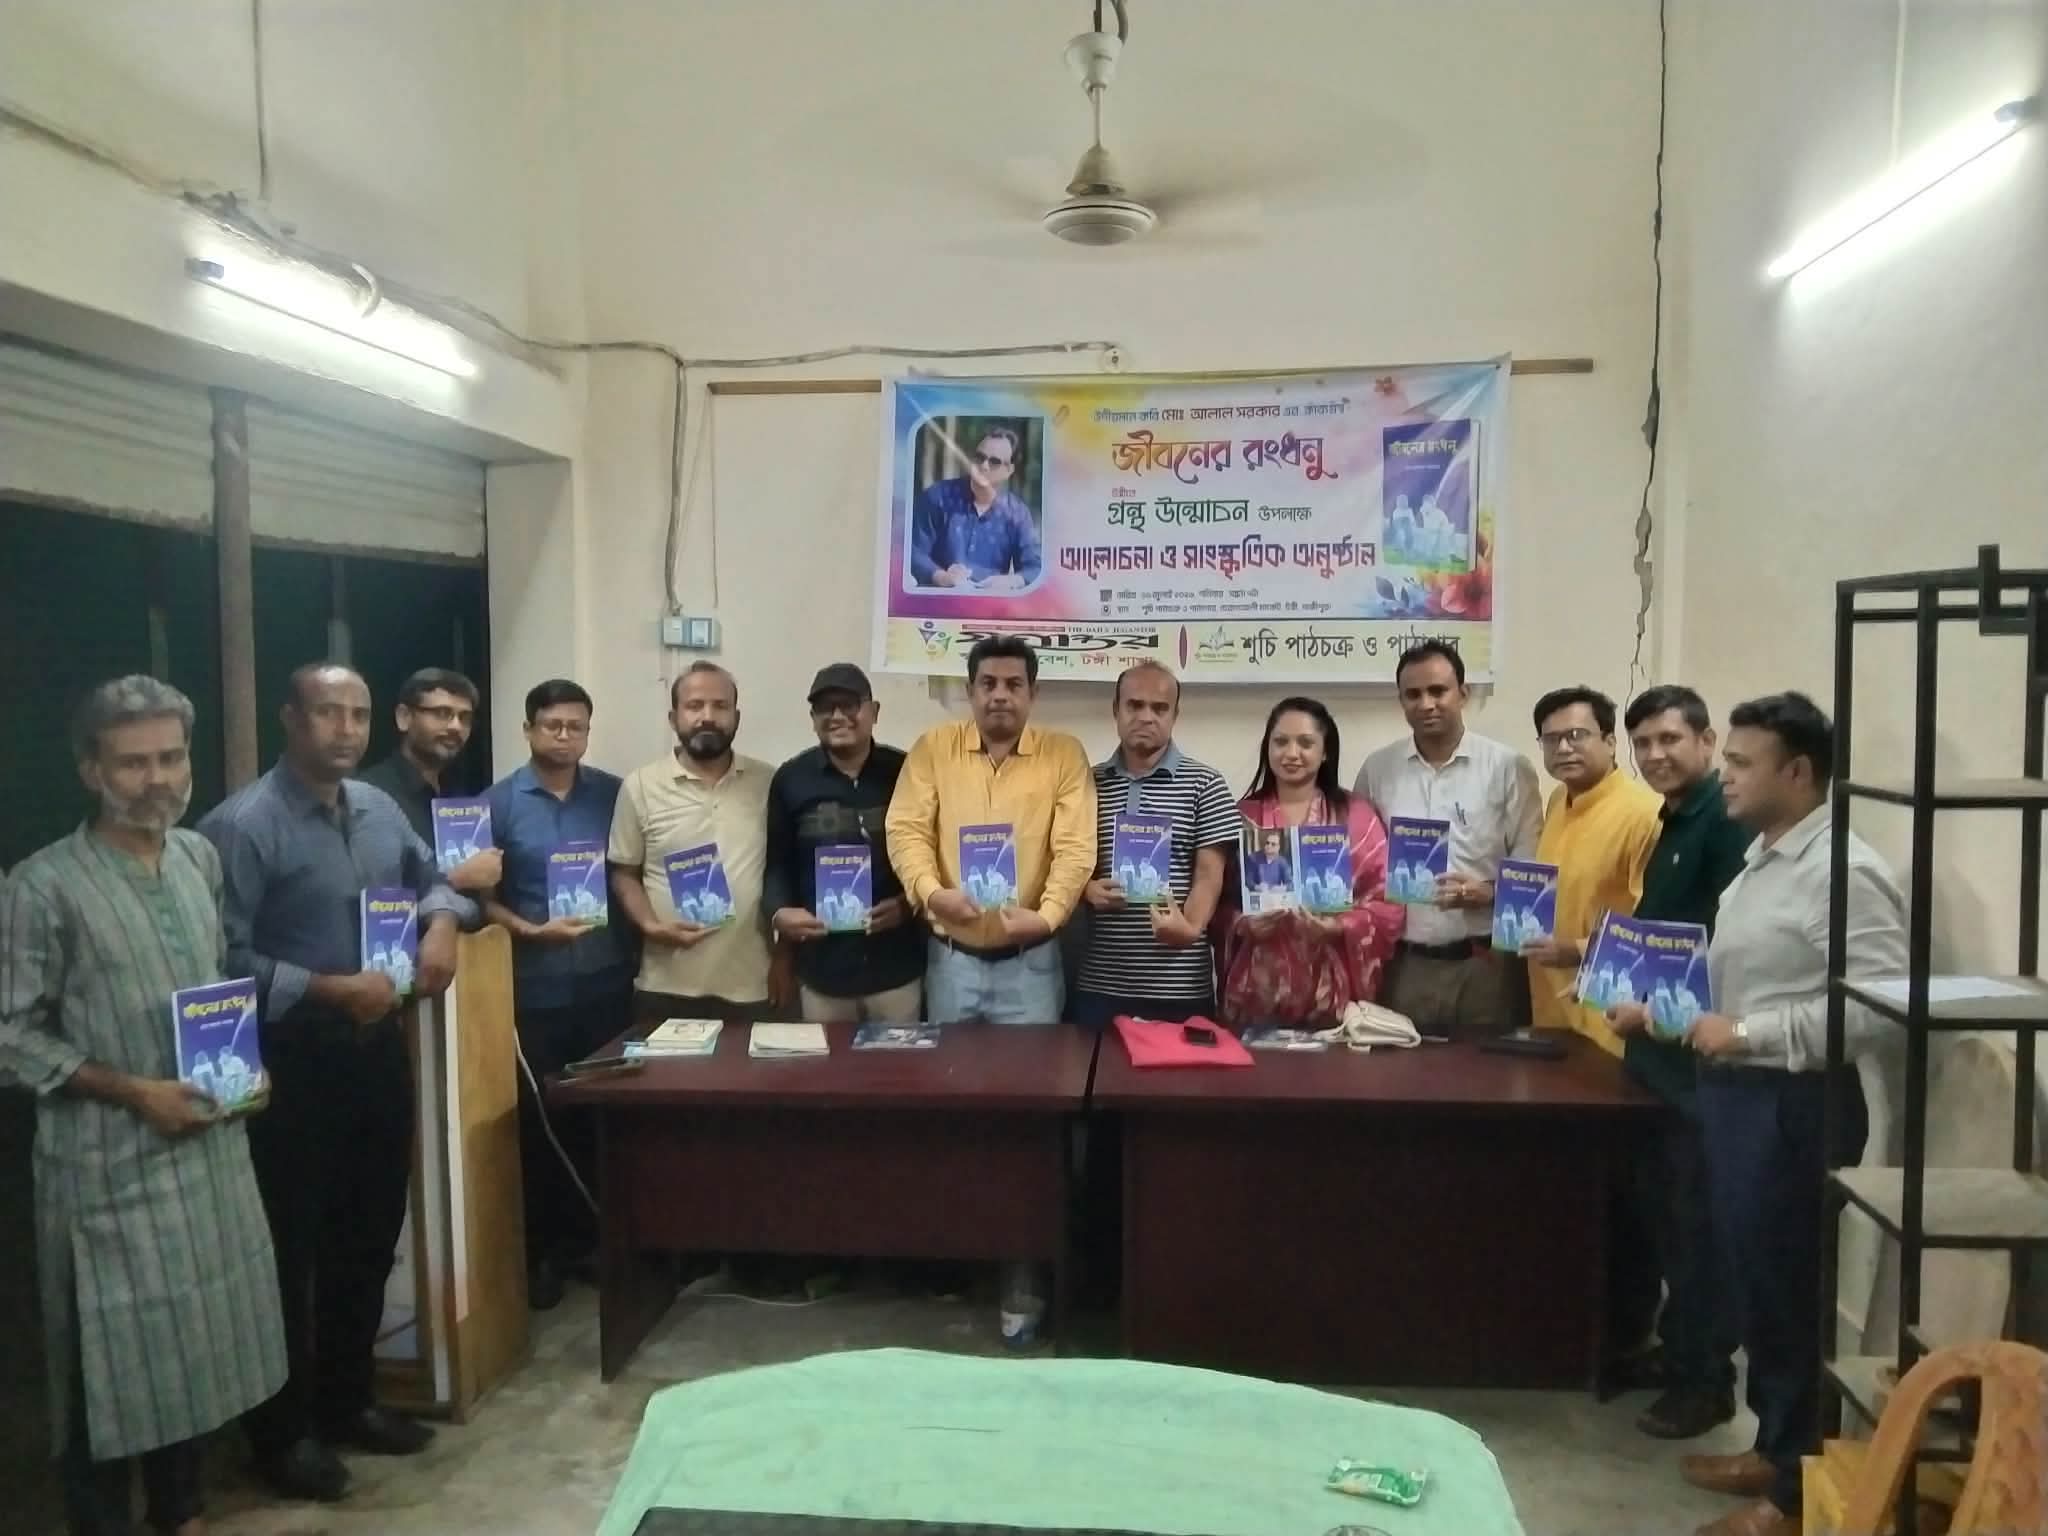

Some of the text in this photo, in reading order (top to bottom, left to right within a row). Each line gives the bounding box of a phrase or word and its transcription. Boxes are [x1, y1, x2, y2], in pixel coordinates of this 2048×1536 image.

[1162, 408, 1184, 420] মোঃ
[1190, 406, 1233, 420] আলাল
[1236, 405, 1280, 419] সরকার
[1112, 430, 1338, 484] জীবনের রংধনু
[1108, 500, 1146, 533] গ্রন্থ
[1155, 497, 1249, 526] উন্মোচন
[1060, 534, 1376, 580] আলোচনা ও সাংস্কৃতিক অনুষ্ঠান
[1240, 628, 1279, 665] শুচি
[1285, 625, 1355, 659] পাঠচক্র
[1362, 636, 1378, 656] ও
